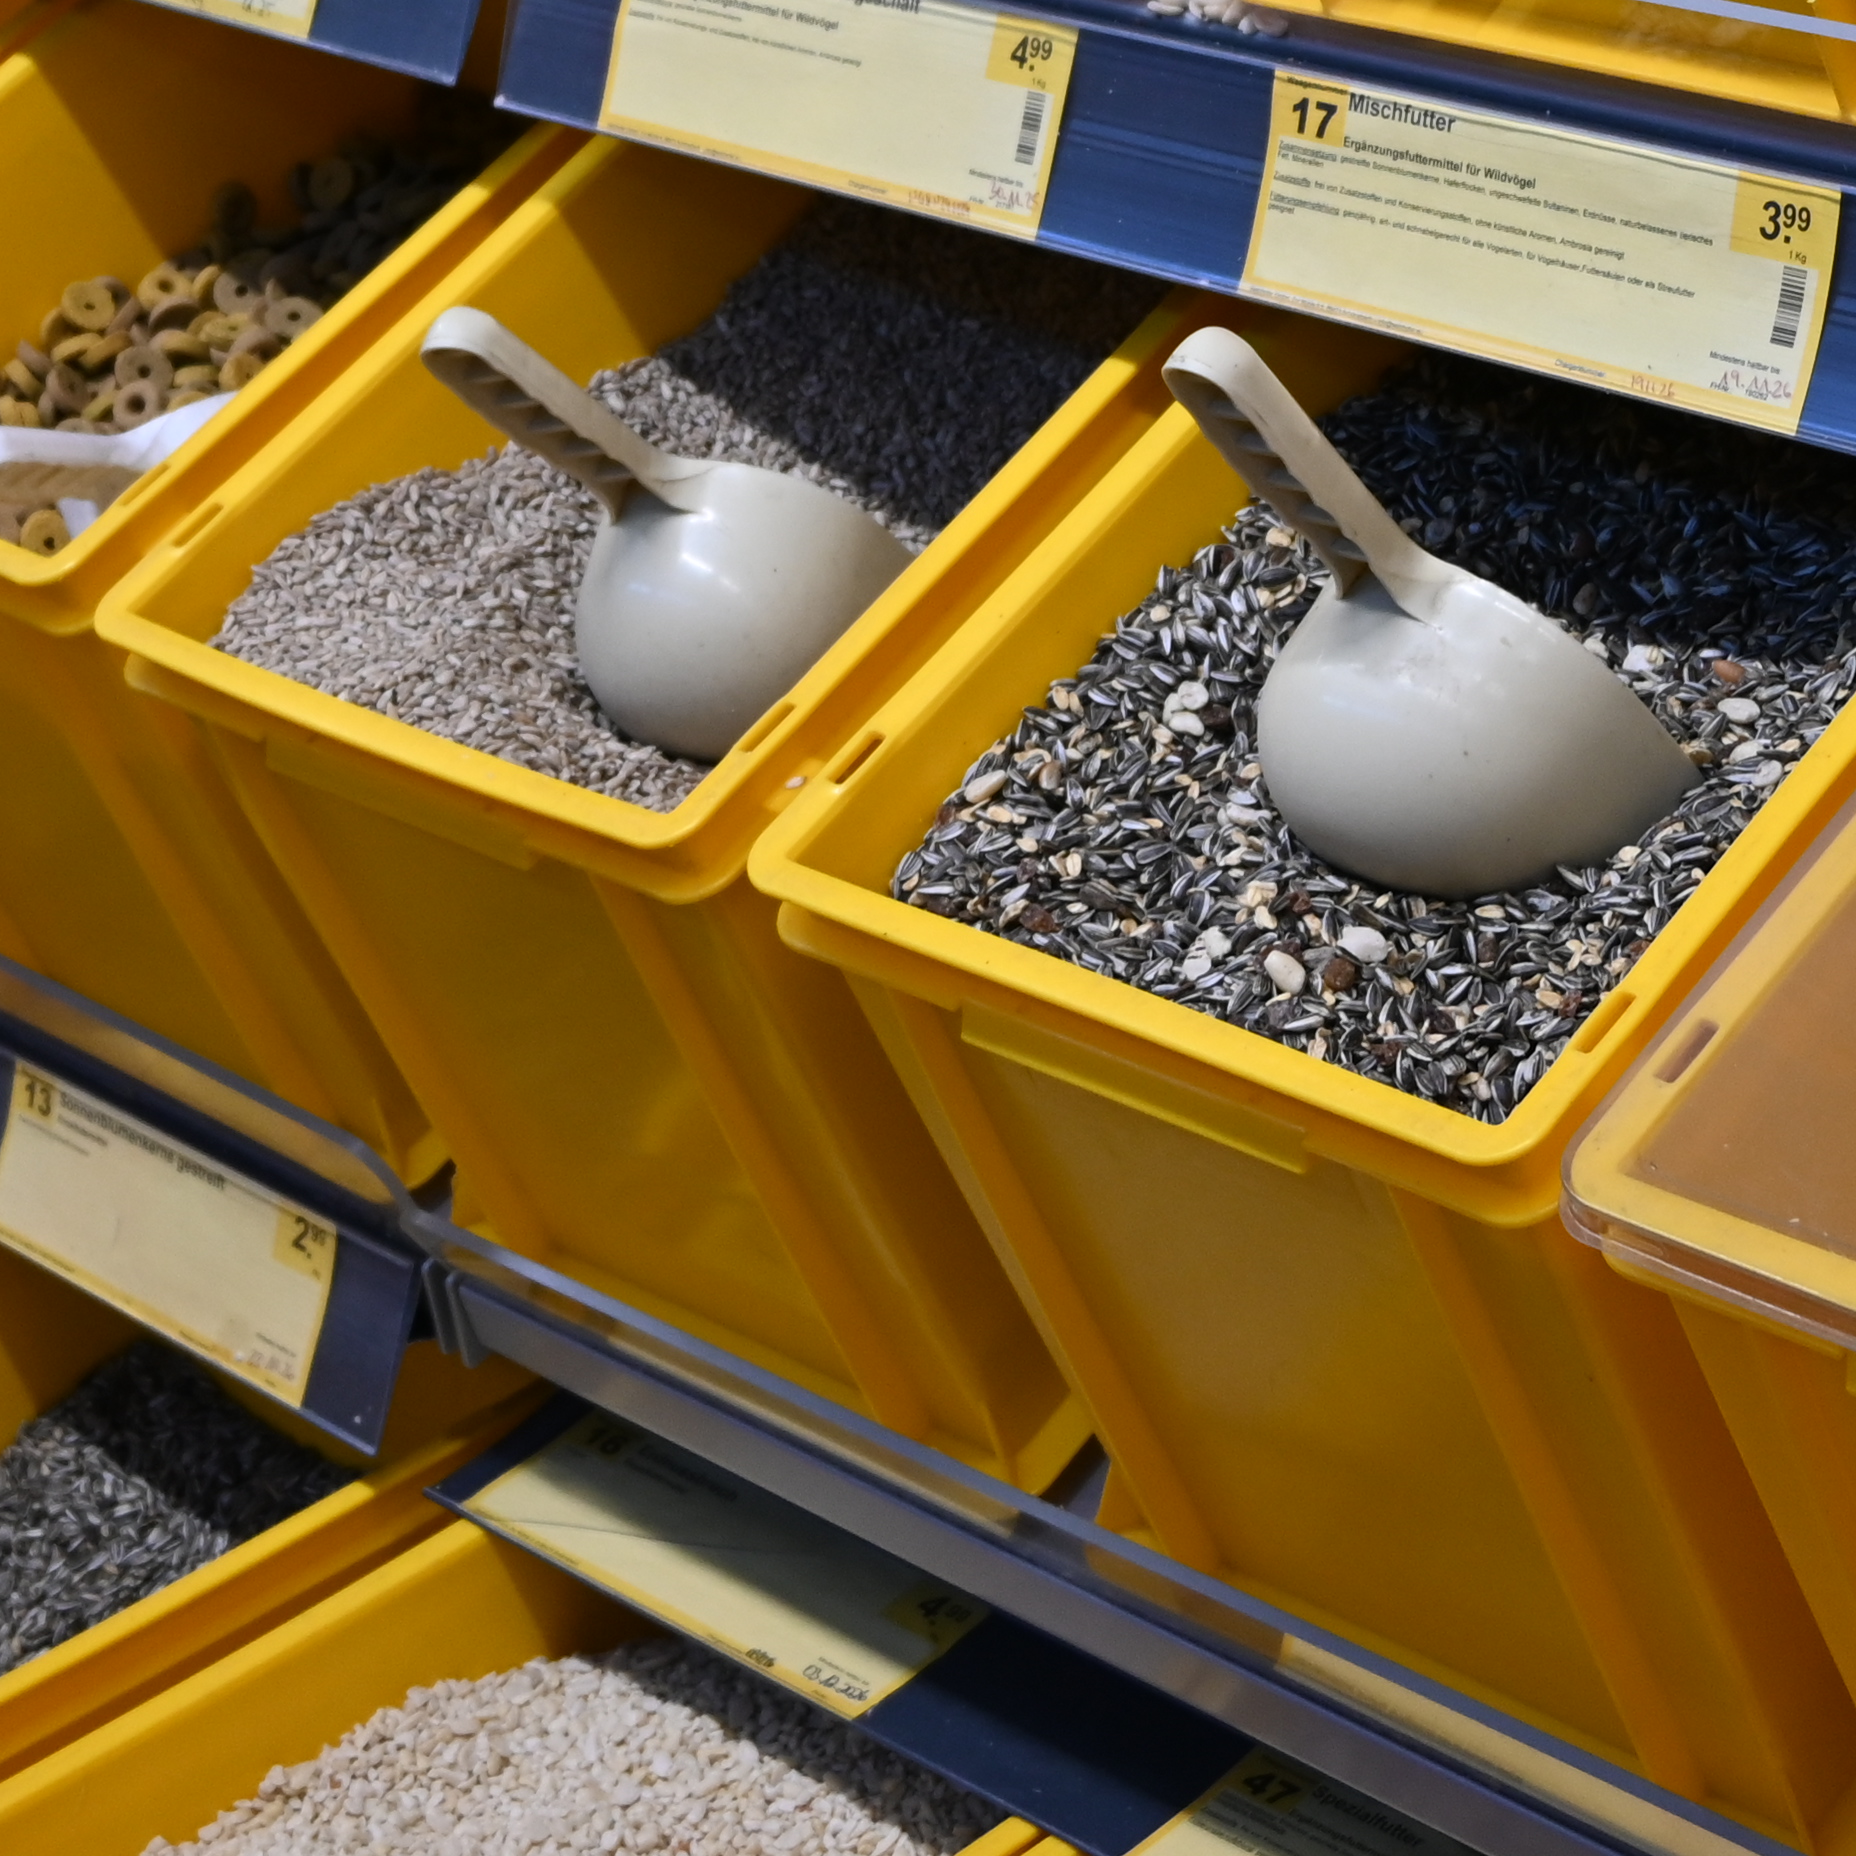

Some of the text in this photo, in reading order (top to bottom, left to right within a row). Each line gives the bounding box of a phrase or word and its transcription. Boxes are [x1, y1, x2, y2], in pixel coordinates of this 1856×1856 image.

[781, 7, 792, 20] für
[795, 11, 839, 31] Wildvögel
[1010, 36, 1053, 72] 4.99
[1292, 97, 1338, 139] 17
[1348, 92, 1456, 133] Mischfutter
[1343, 136, 1536, 190] Ergänzungsfuttermittel für Wildvögel
[1759, 201, 1811, 244] 3.99
[1788, 250, 1807, 264] 1 Kg
[24, 1080, 51, 1117] 13
[61, 1092, 174, 1163] Sonnenblumenkerne
[1243, 1772, 1300, 1805] 47
[1312, 1785, 1423, 1849] Spezialfutter
